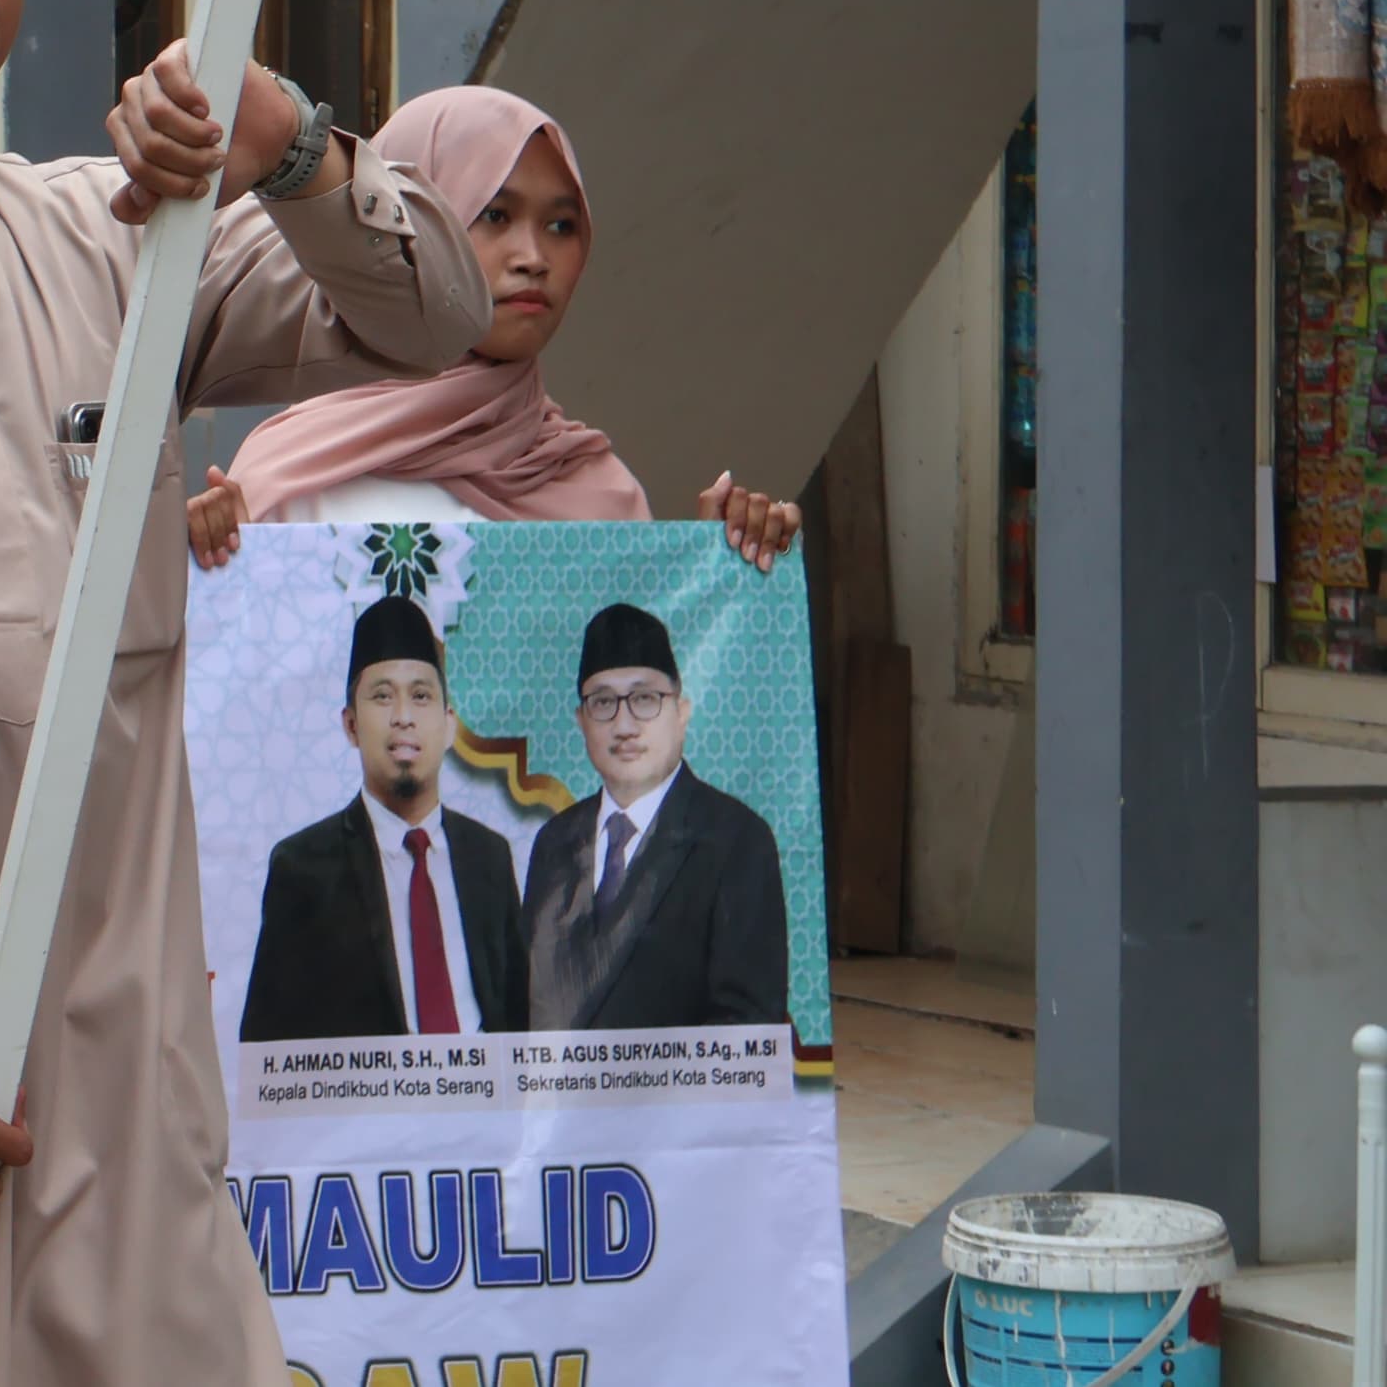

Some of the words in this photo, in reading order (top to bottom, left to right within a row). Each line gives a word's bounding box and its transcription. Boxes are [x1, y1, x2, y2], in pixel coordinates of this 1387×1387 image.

[264, 1056, 279, 1074] H.
[282, 1052, 345, 1072] AHMAD
[349, 1050, 397, 1071] NURI,
[402, 1048, 443, 1069] S.H.,
[448, 1048, 486, 1067] M.Si
[562, 1043, 608, 1063] AGUS
[612, 1042, 692, 1062] SURYADIN,
[258, 1082, 307, 1103] Kepala
[312, 1078, 388, 1099] Dindikbud
[394, 1077, 431, 1097] Kota
[436, 1076, 494, 1098] Serang
[517, 1071, 597, 1092] Sekretaris
[601, 1068, 668, 1090] Dindikbud
[673, 1067, 707, 1087] Kota
[712, 1066, 766, 1087] Serang
